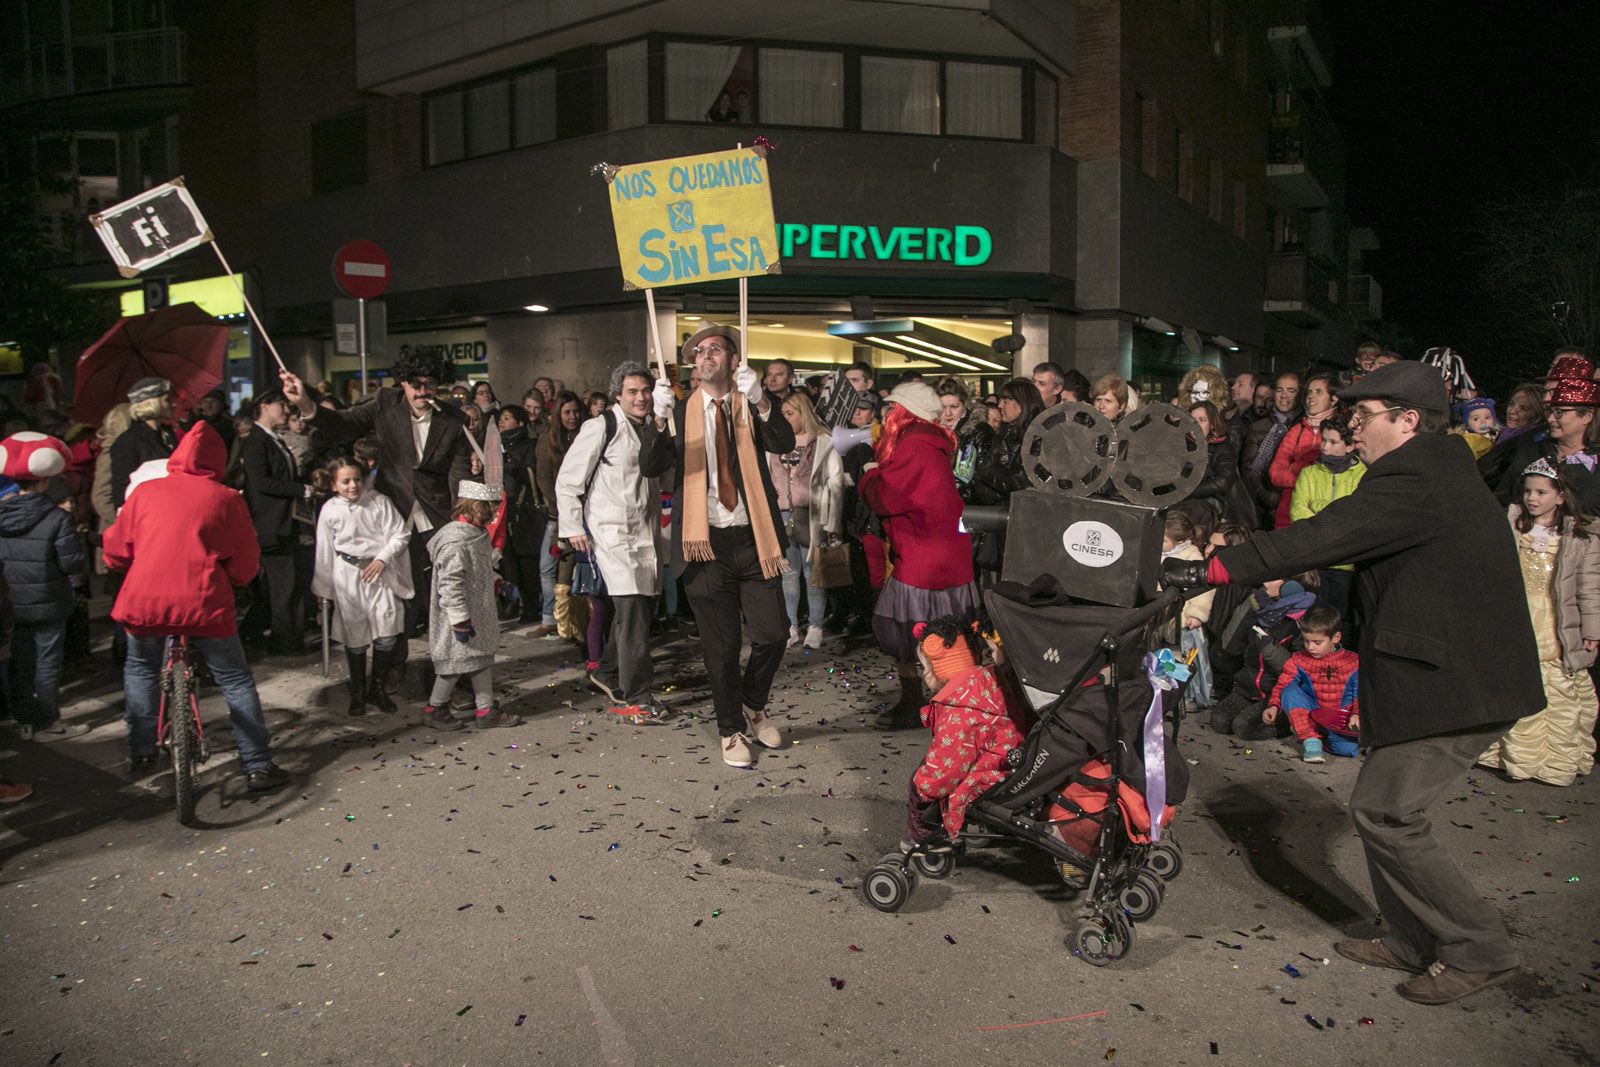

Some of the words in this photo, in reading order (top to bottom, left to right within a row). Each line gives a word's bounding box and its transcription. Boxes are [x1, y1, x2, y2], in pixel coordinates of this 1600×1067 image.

[614, 170, 656, 202] NOS
[669, 156, 763, 194] QUEDAMOS
[776, 223, 993, 267] PERVERD
[1071, 543, 1114, 558] CINESA
